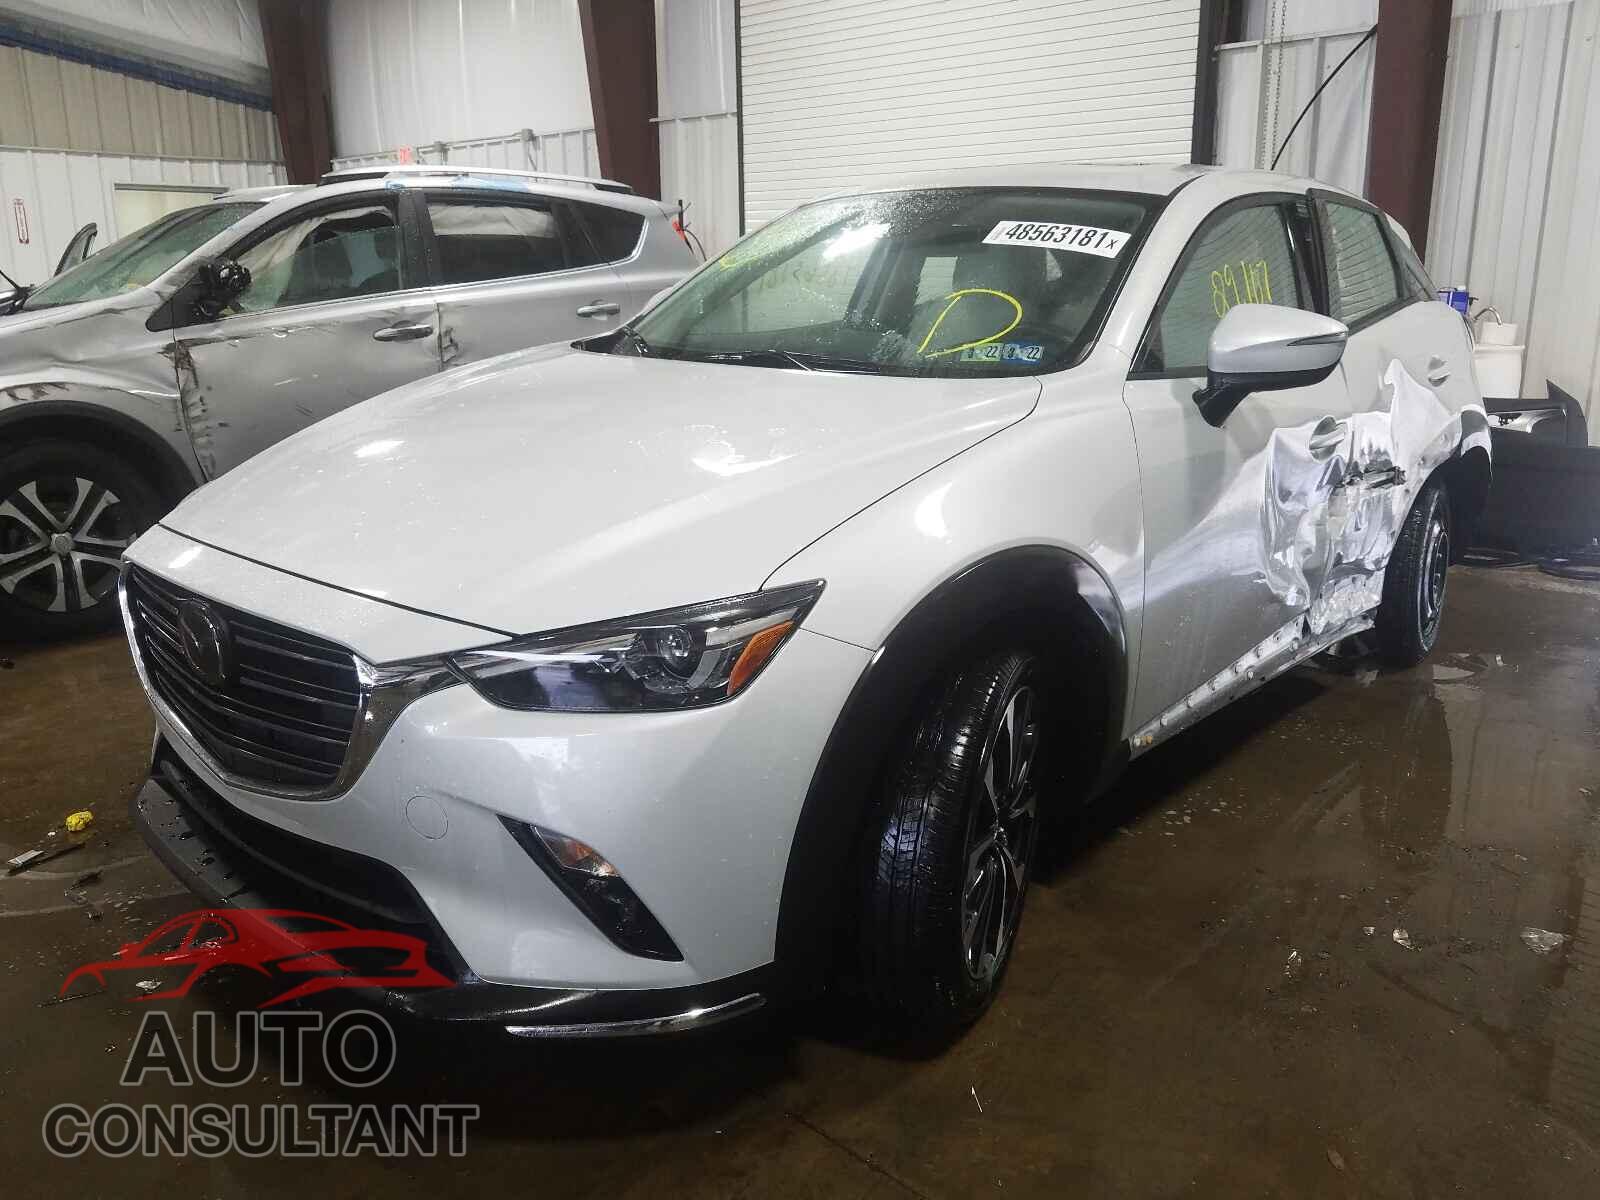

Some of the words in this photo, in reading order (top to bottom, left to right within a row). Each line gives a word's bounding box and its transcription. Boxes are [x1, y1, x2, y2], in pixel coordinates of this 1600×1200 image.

[1005, 223, 1109, 249] 48563181
[985, 345, 998, 358] 22
[1026, 346, 1040, 359] 22
